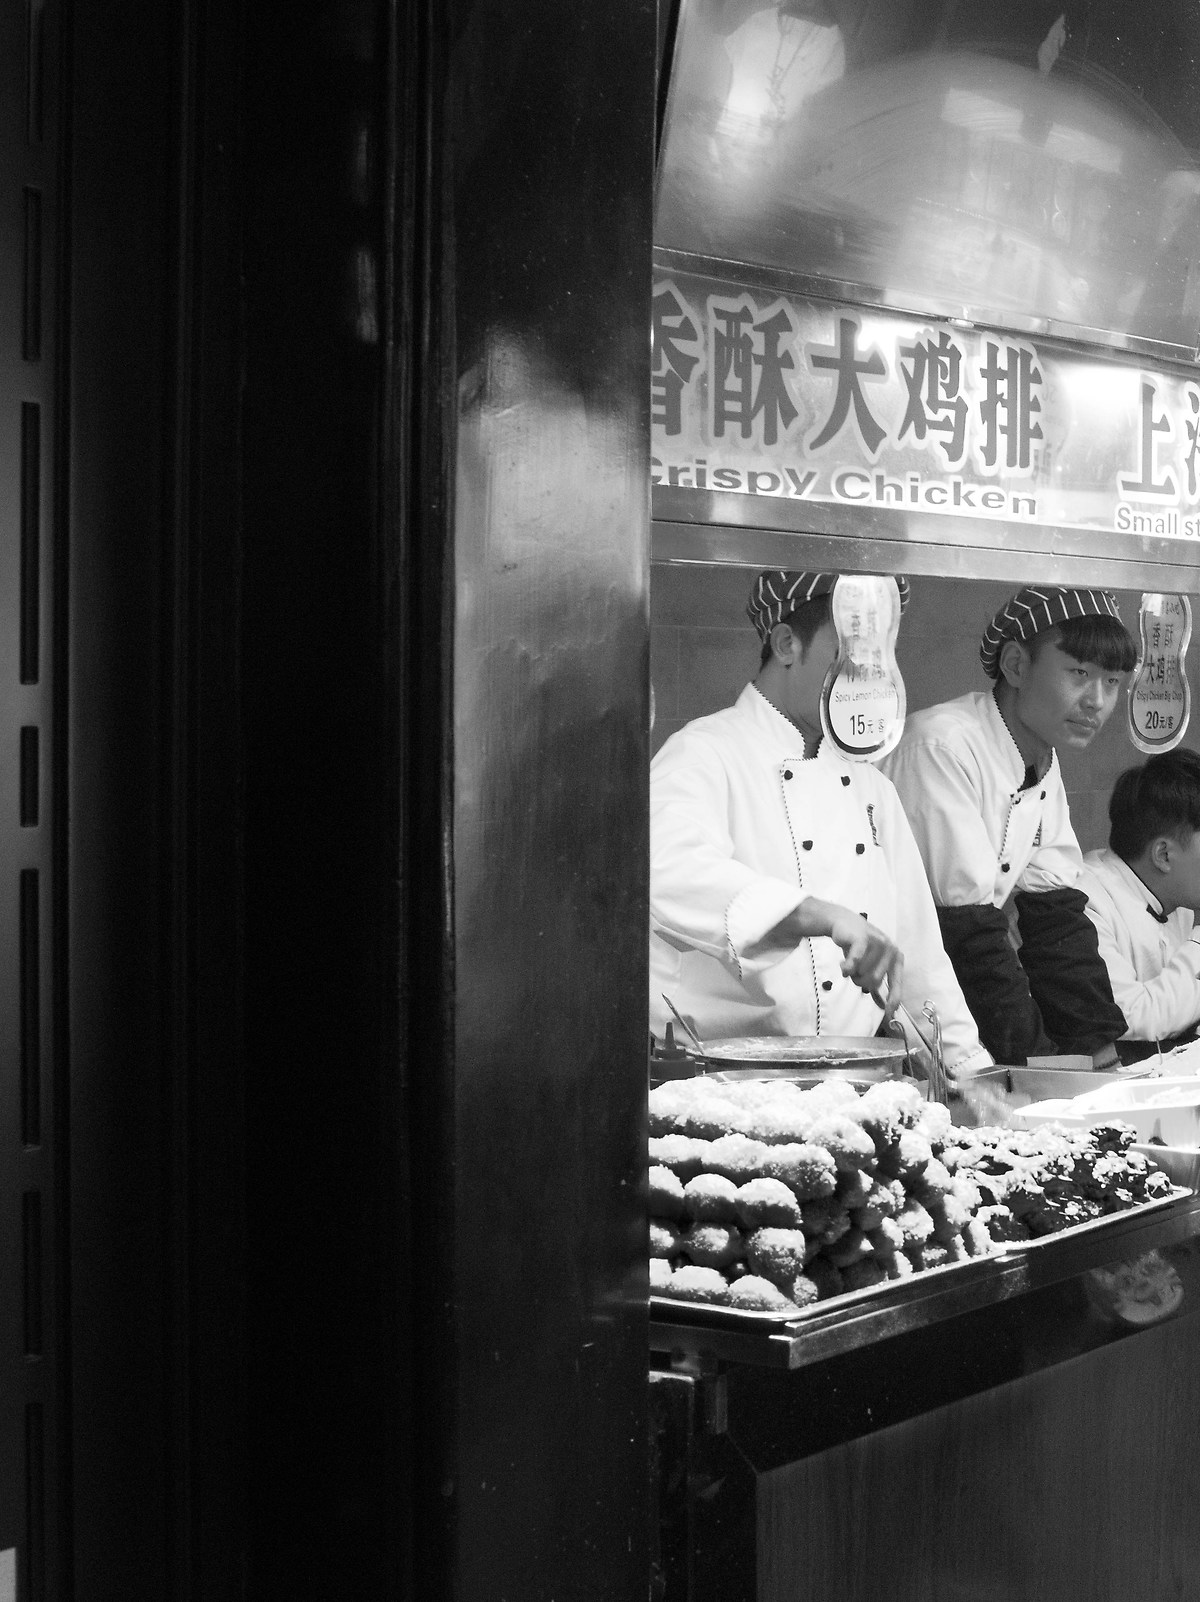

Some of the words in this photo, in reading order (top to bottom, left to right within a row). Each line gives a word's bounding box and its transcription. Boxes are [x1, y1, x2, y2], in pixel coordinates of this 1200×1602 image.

[652, 289, 1044, 469] 香酥大鸡排
[651, 456, 817, 496] rispy
[834, 472, 1037, 515] Chicken
[1117, 507, 1178, 535] Small
[852, 691, 872, 702] Lemon
